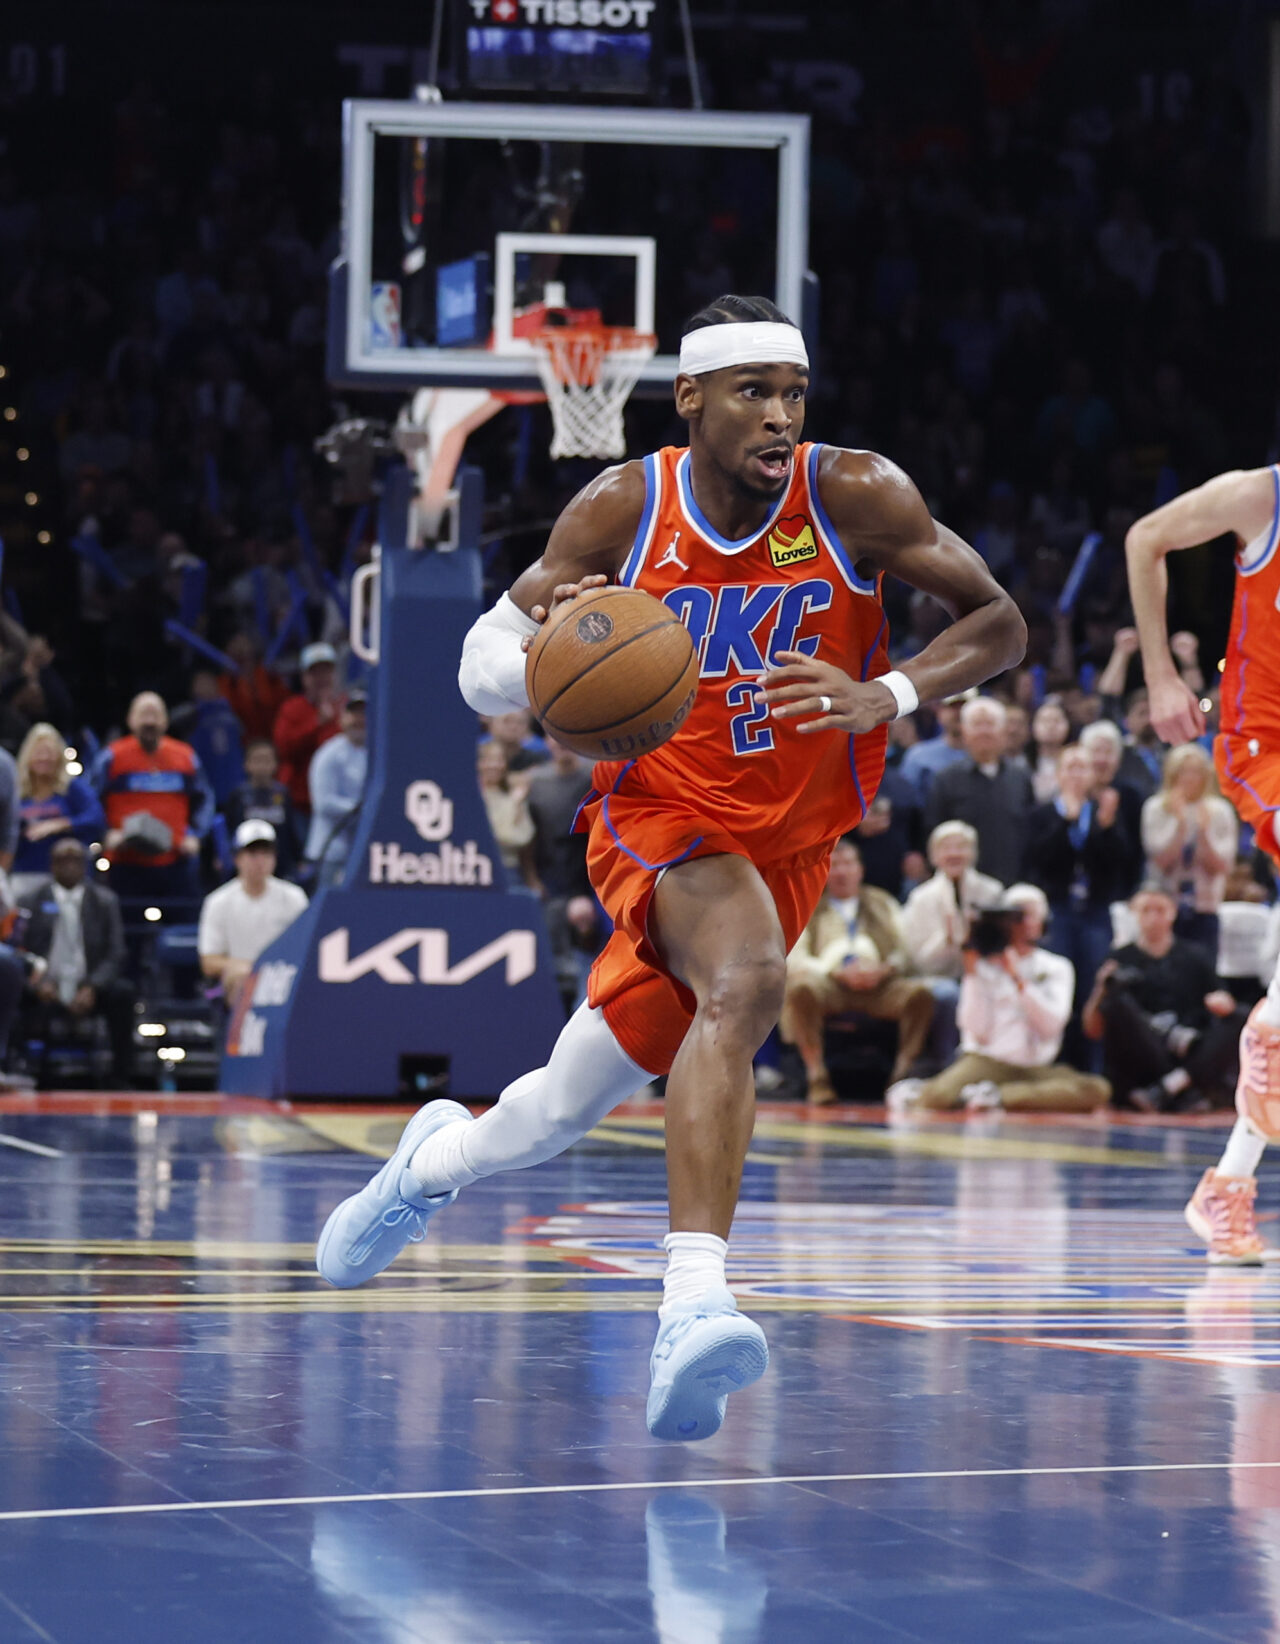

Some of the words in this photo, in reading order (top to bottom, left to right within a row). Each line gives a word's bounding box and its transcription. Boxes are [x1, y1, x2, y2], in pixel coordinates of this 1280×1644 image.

[599, 687, 698, 757] Wilson
[726, 681, 775, 757] 2
[369, 840, 493, 887] Health
[318, 926, 537, 987] KIA
